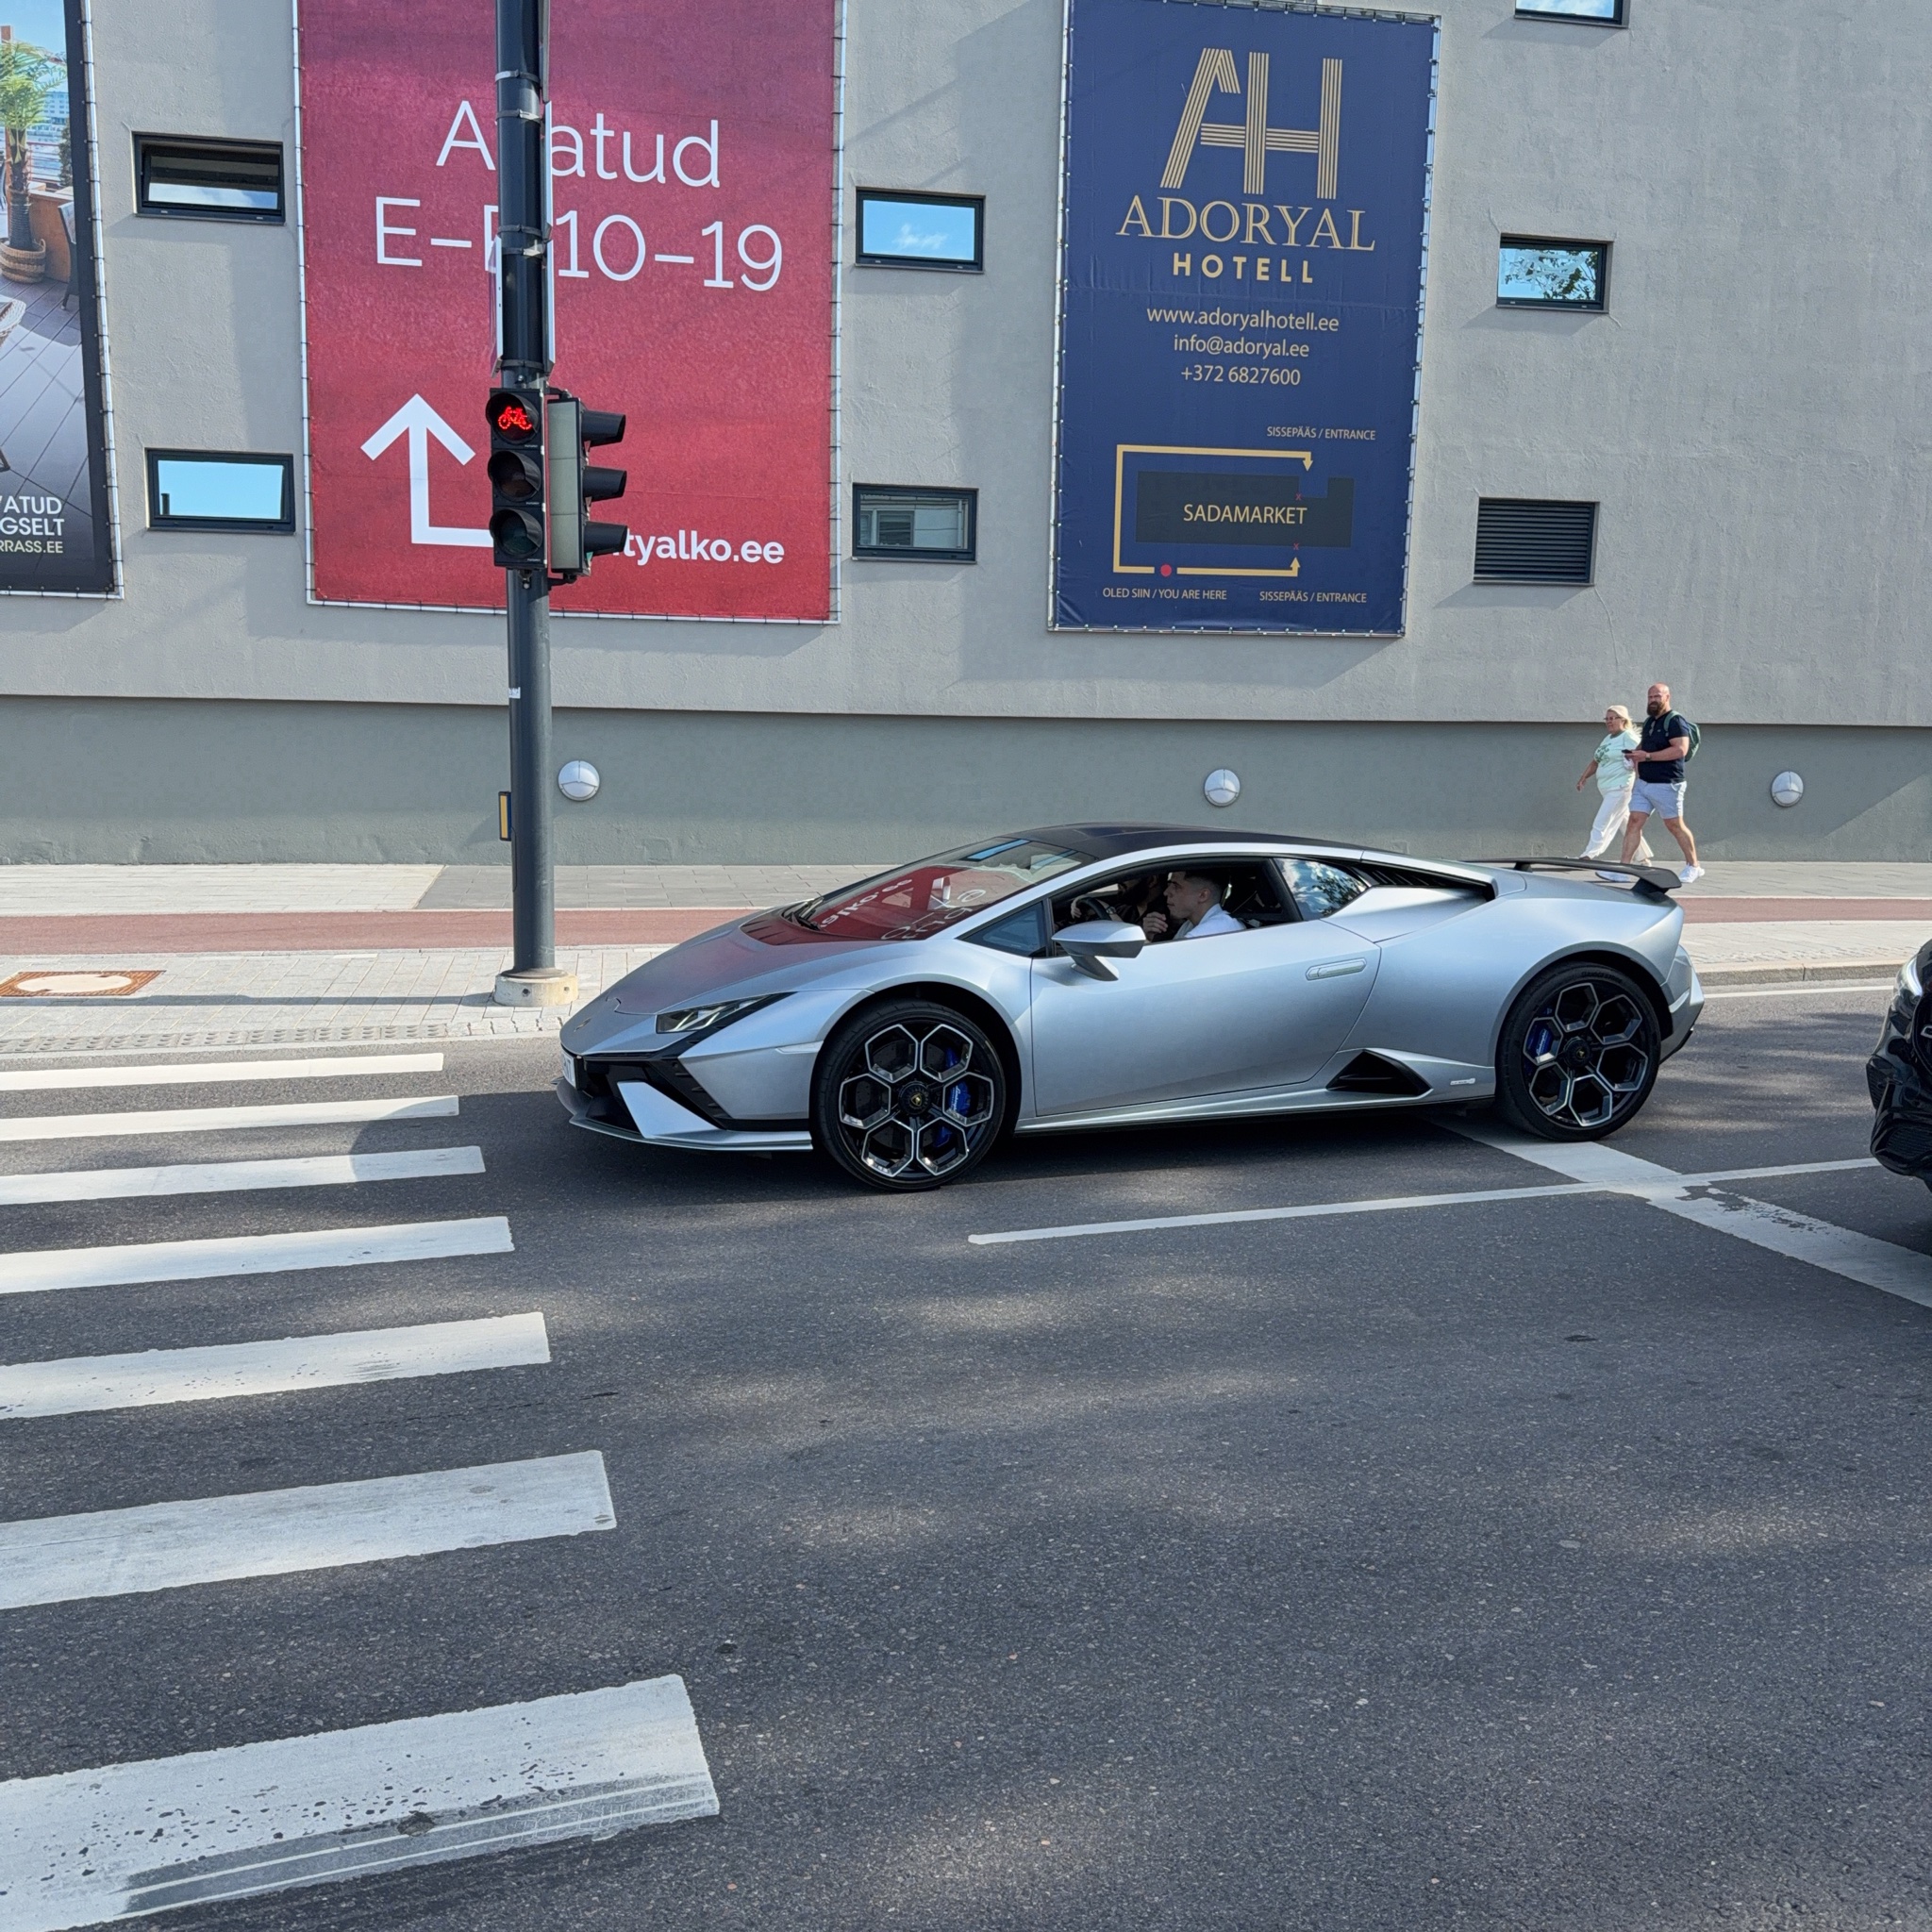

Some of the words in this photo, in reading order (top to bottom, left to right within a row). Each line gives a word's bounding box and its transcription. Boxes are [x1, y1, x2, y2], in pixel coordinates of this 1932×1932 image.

[436, 100, 720, 189] Aatud
[1115, 194, 1376, 252] ADORYAL
[1173, 252, 1313, 284] HOTELL
[1146, 307, 1340, 332] www.adoryalhotell.ee
[1174, 333, 1310, 360] info@adoryal.ee
[1181, 364, 1224, 383] +372
[1227, 365, 1301, 386] 6827600
[1266, 425, 1318, 440] SISSEPÄÄS
[1324, 428, 1376, 441] ENTRANCE
[0, 495, 62, 515] ATUD
[1183, 503, 1308, 525] SADAMARKET
[613, 528, 785, 566] tyalko.ee
[1102, 587, 1130, 600] OLED
[1131, 587, 1151, 600] SIIN
[1158, 589, 1181, 601] YOU
[1181, 589, 1202, 602] ARE
[1202, 590, 1227, 602] HERE
[1259, 590, 1309, 603] SISSEPÄÄS
[1316, 591, 1368, 604] ENTRANCE
